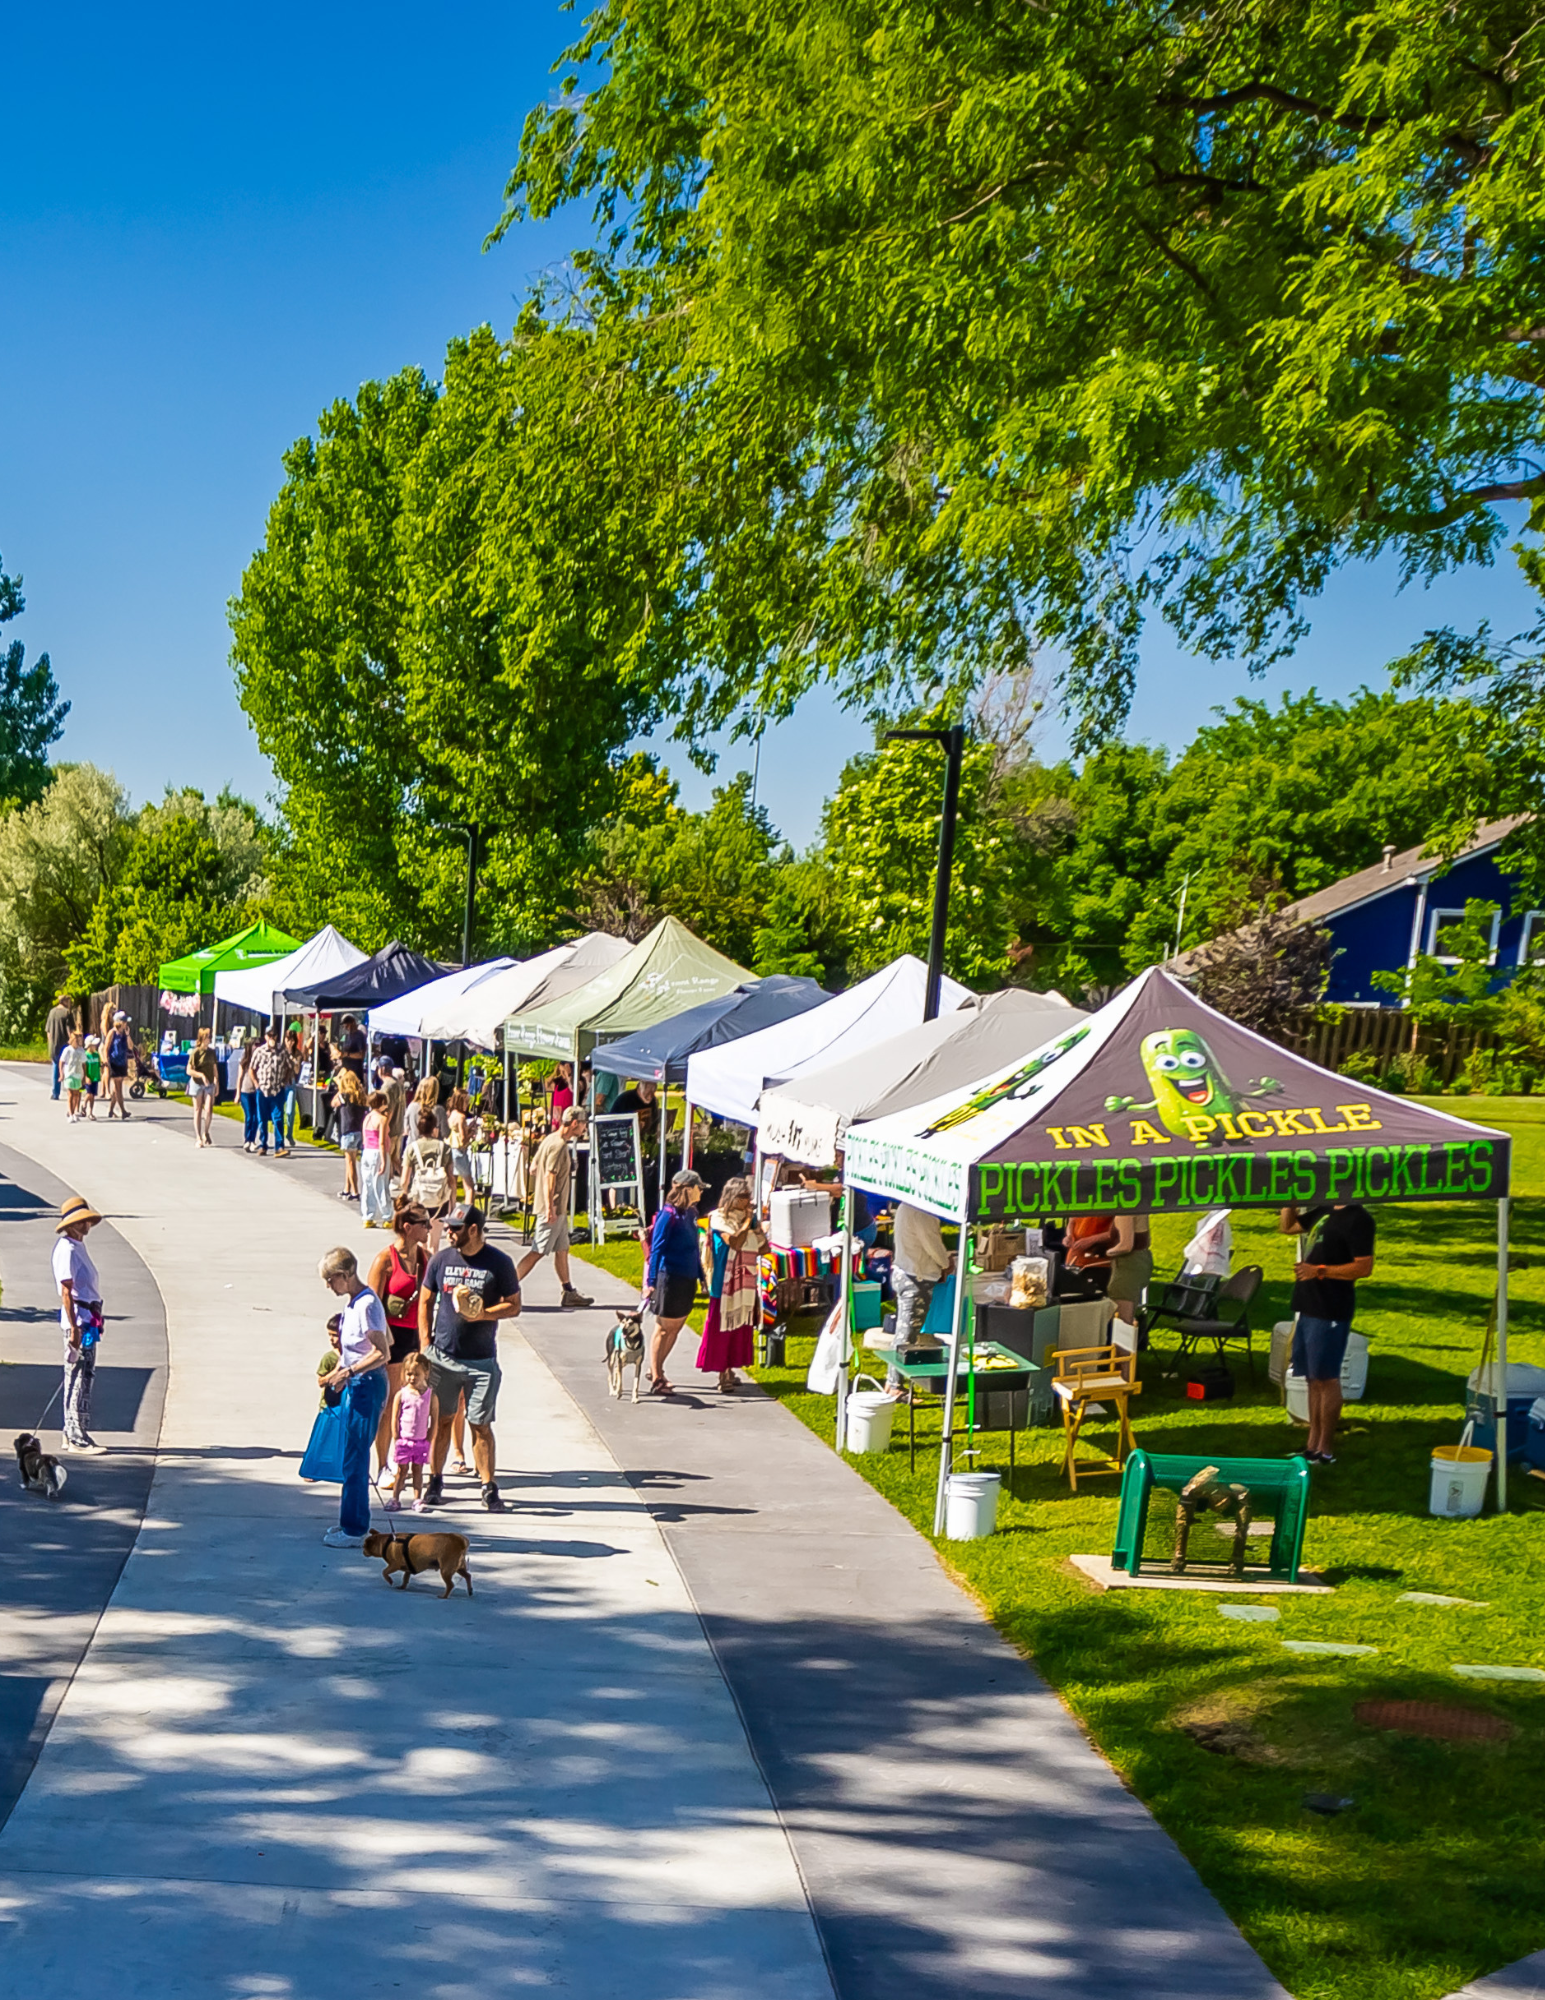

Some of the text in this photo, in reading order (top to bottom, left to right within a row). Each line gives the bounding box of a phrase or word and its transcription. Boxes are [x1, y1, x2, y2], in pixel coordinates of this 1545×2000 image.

[1046, 1103, 1382, 1149] IN A PICKLE
[977, 1139, 1494, 1215] PICKLES PICKLES PICKLES
